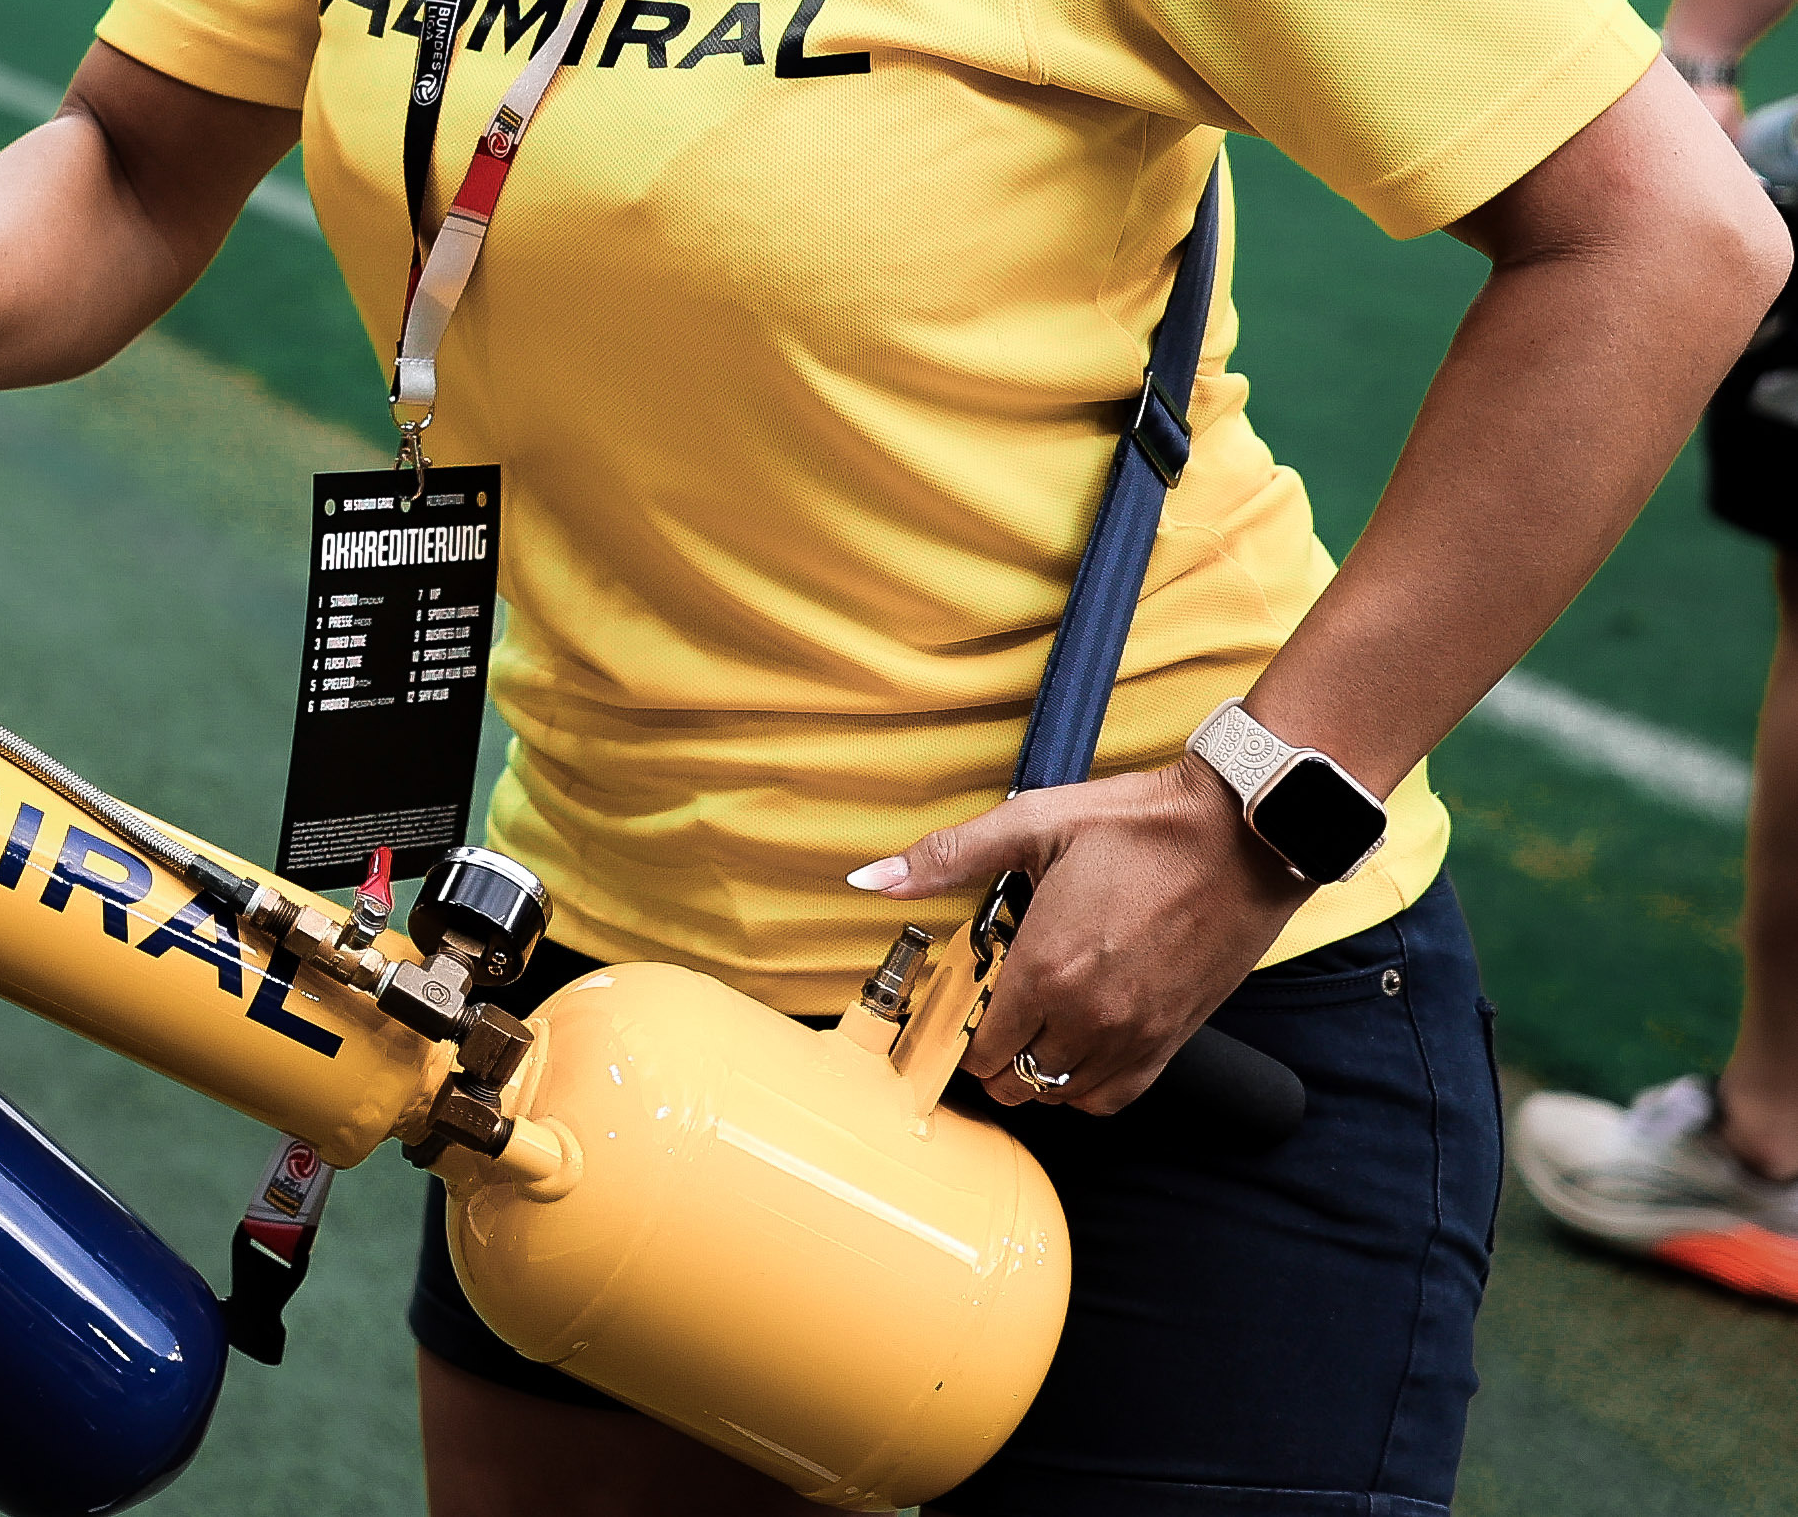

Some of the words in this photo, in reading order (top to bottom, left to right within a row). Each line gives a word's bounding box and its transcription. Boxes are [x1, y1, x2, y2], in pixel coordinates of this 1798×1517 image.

[424, 5, 438, 41] LIGA
[431, 6, 451, 71] BUNDES
[320, 524, 487, 571] AKKREDITIERUNG
[417, 589, 424, 601] 7
[318, 596, 323, 609] 1
[316, 617, 323, 630] 2
[328, 614, 353, 629] PRESSE
[314, 638, 321, 651] 3
[312, 659, 319, 671] 4
[324, 657, 345, 670] FLASH
[310, 679, 317, 692] 5
[322, 676, 355, 691] SPIELFELD
[406, 690, 416, 703] 12
[308, 700, 315, 713] 6
